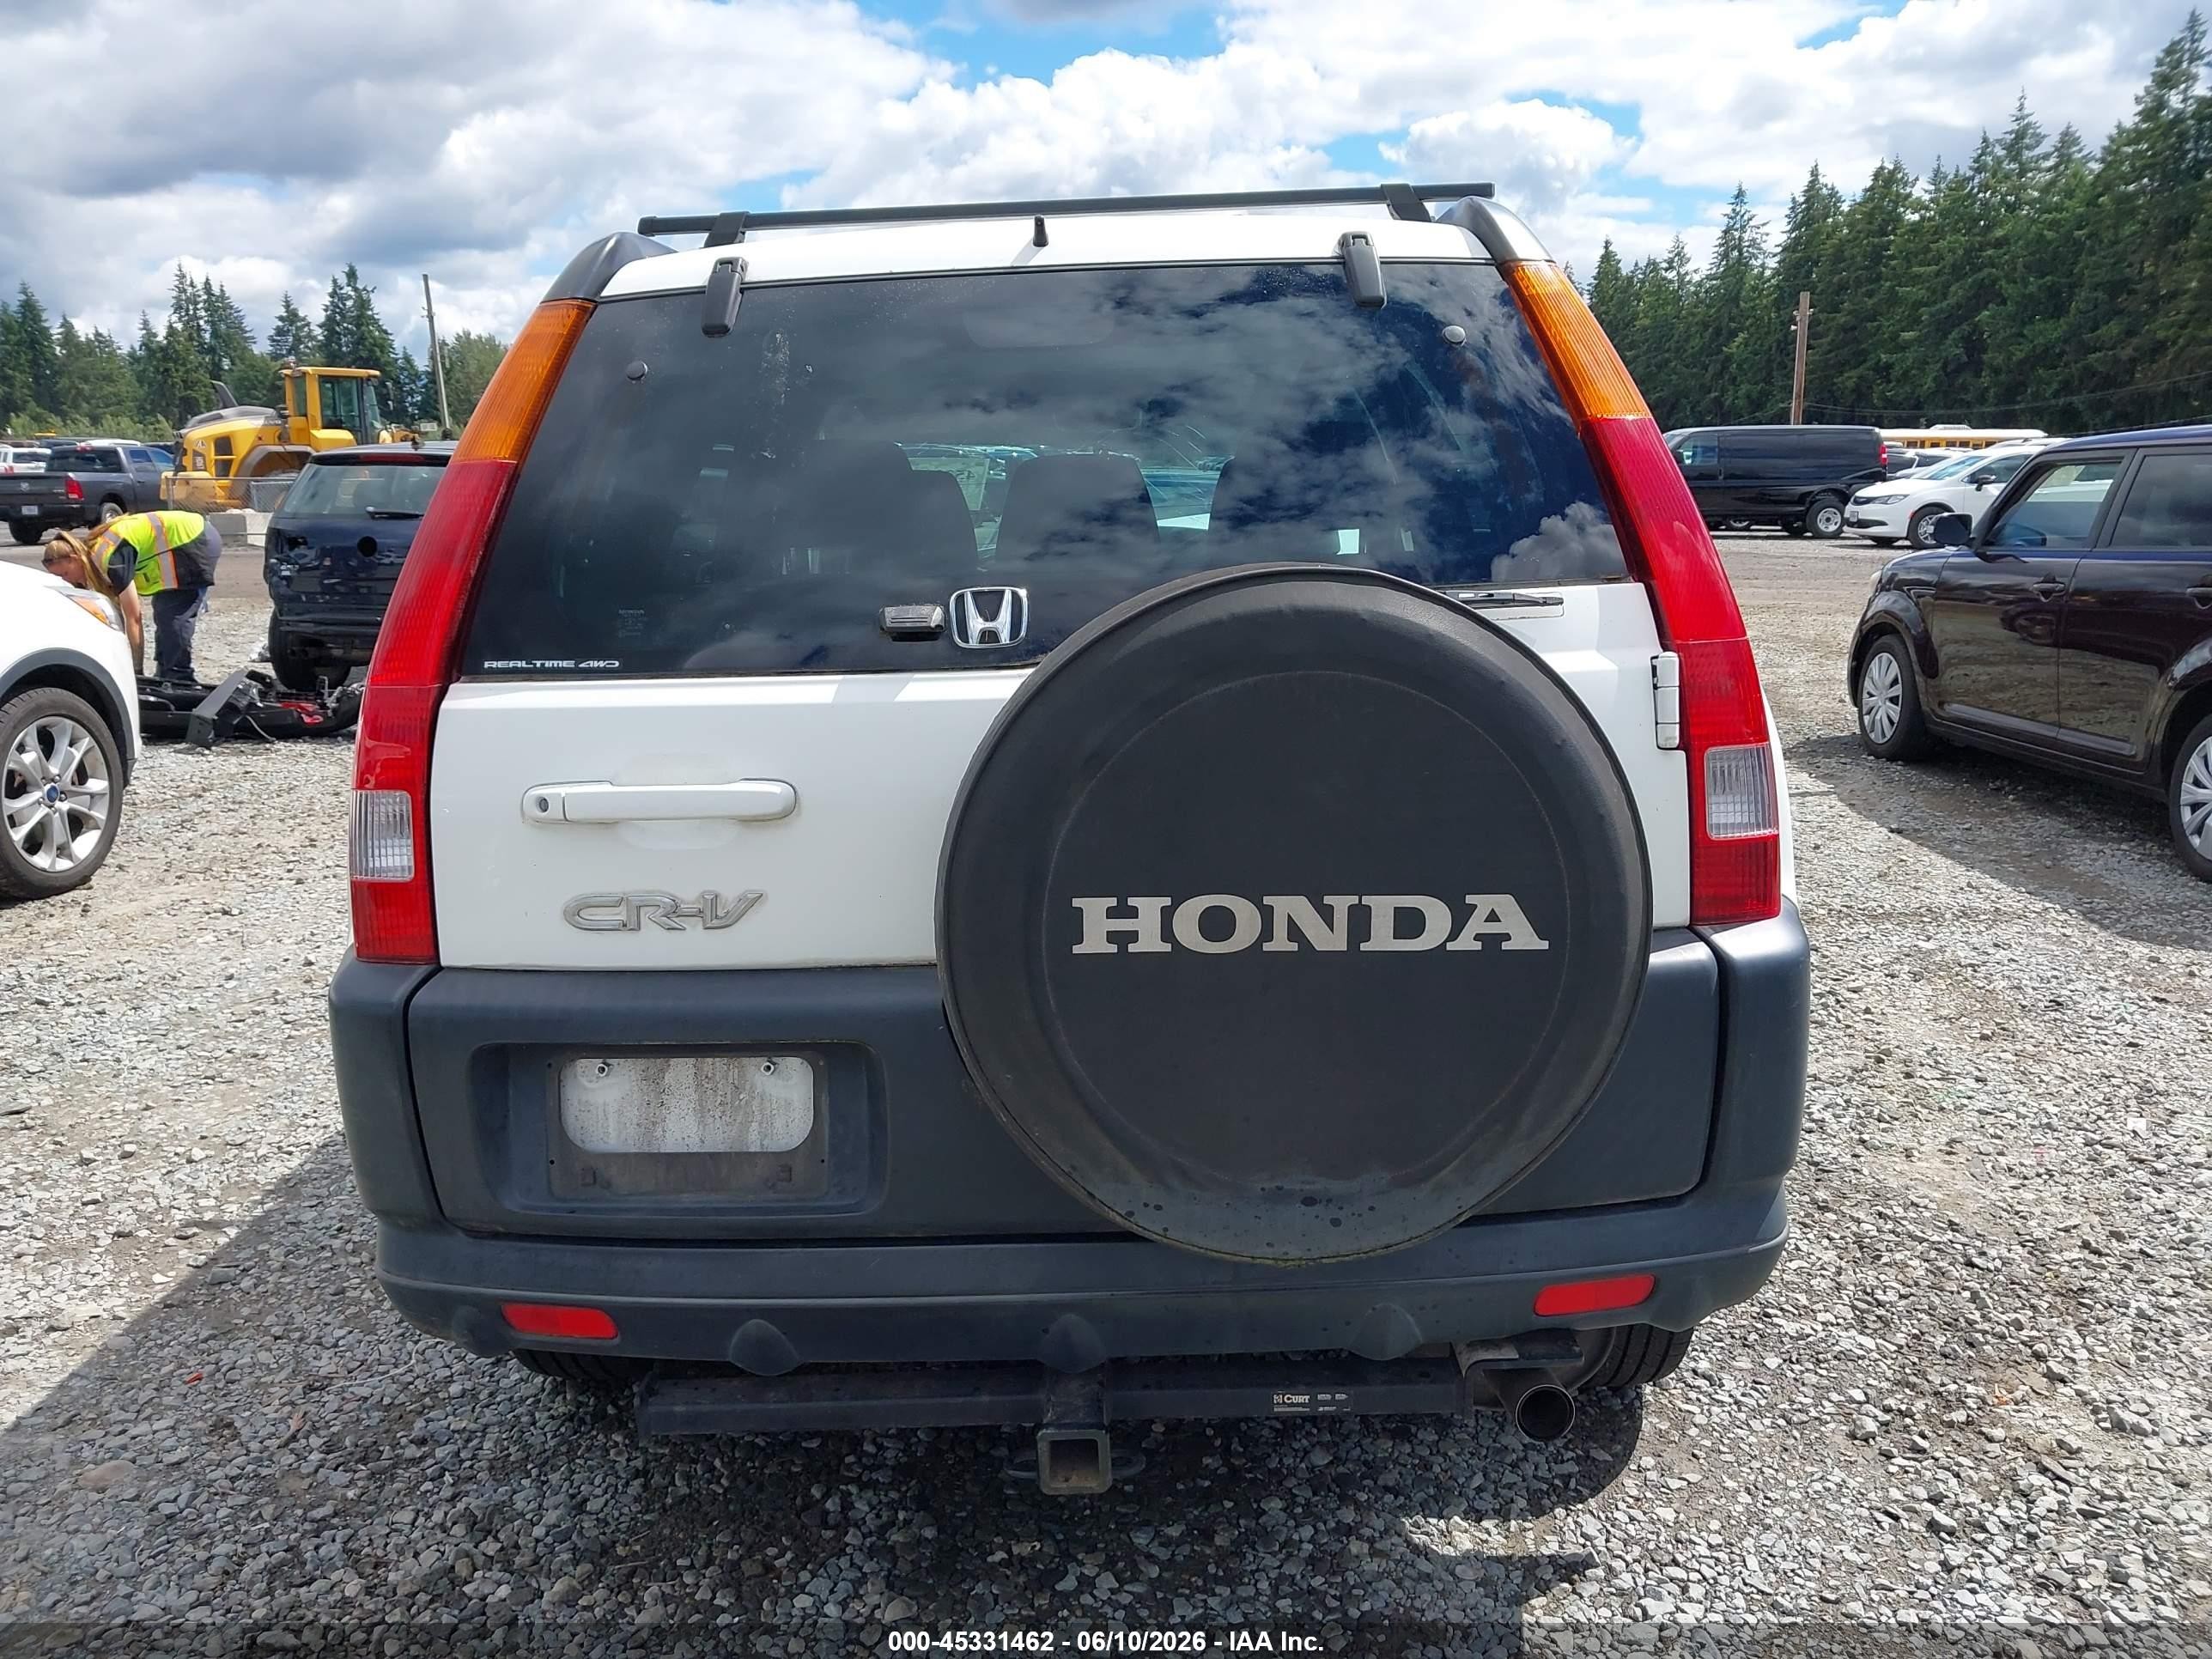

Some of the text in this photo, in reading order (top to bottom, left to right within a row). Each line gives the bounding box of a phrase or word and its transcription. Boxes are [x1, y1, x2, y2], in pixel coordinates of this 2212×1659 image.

[483, 659, 620, 669] REALTIME 4WD
[563, 891, 763, 931] CR-V
[1072, 894, 1549, 954] HONDA
